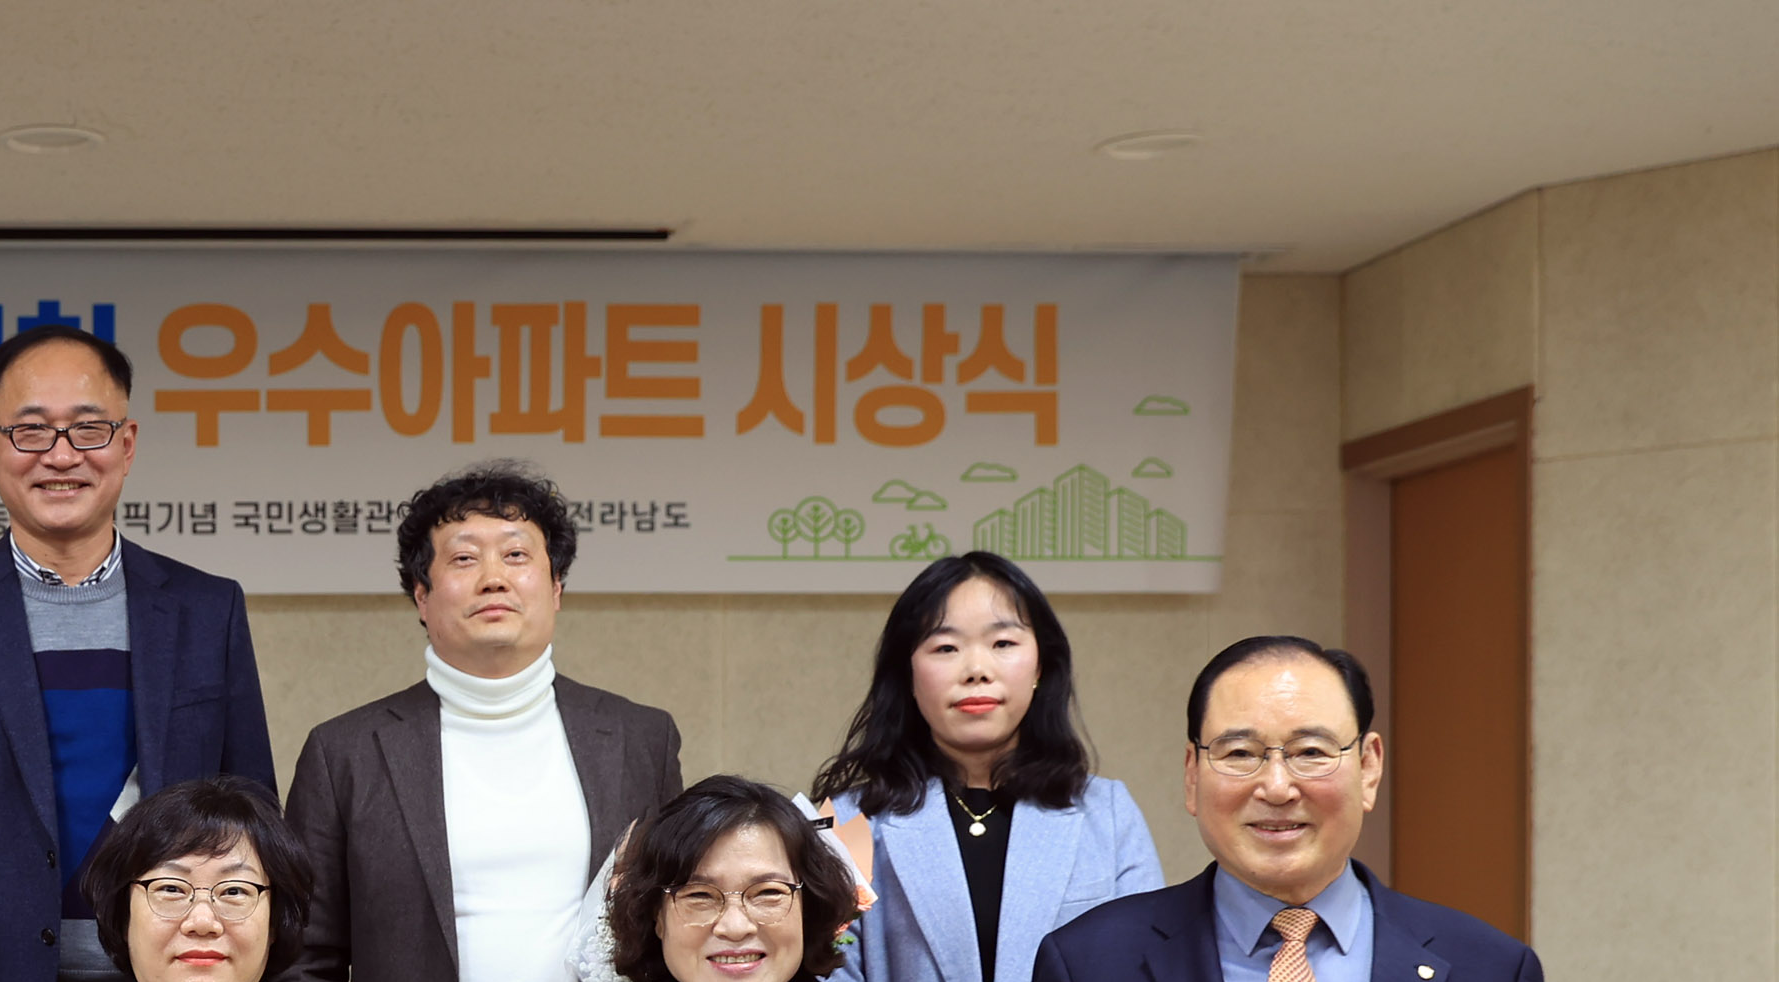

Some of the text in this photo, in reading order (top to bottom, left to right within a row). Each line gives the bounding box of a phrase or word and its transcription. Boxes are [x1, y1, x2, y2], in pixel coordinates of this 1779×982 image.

[154, 300, 706, 448] 우수아파트
[736, 302, 1060, 449] 시상식
[113, 501, 216, 535] 픽기념
[232, 500, 395, 535] 국민생활관
[567, 500, 691, 533] 전라남도
